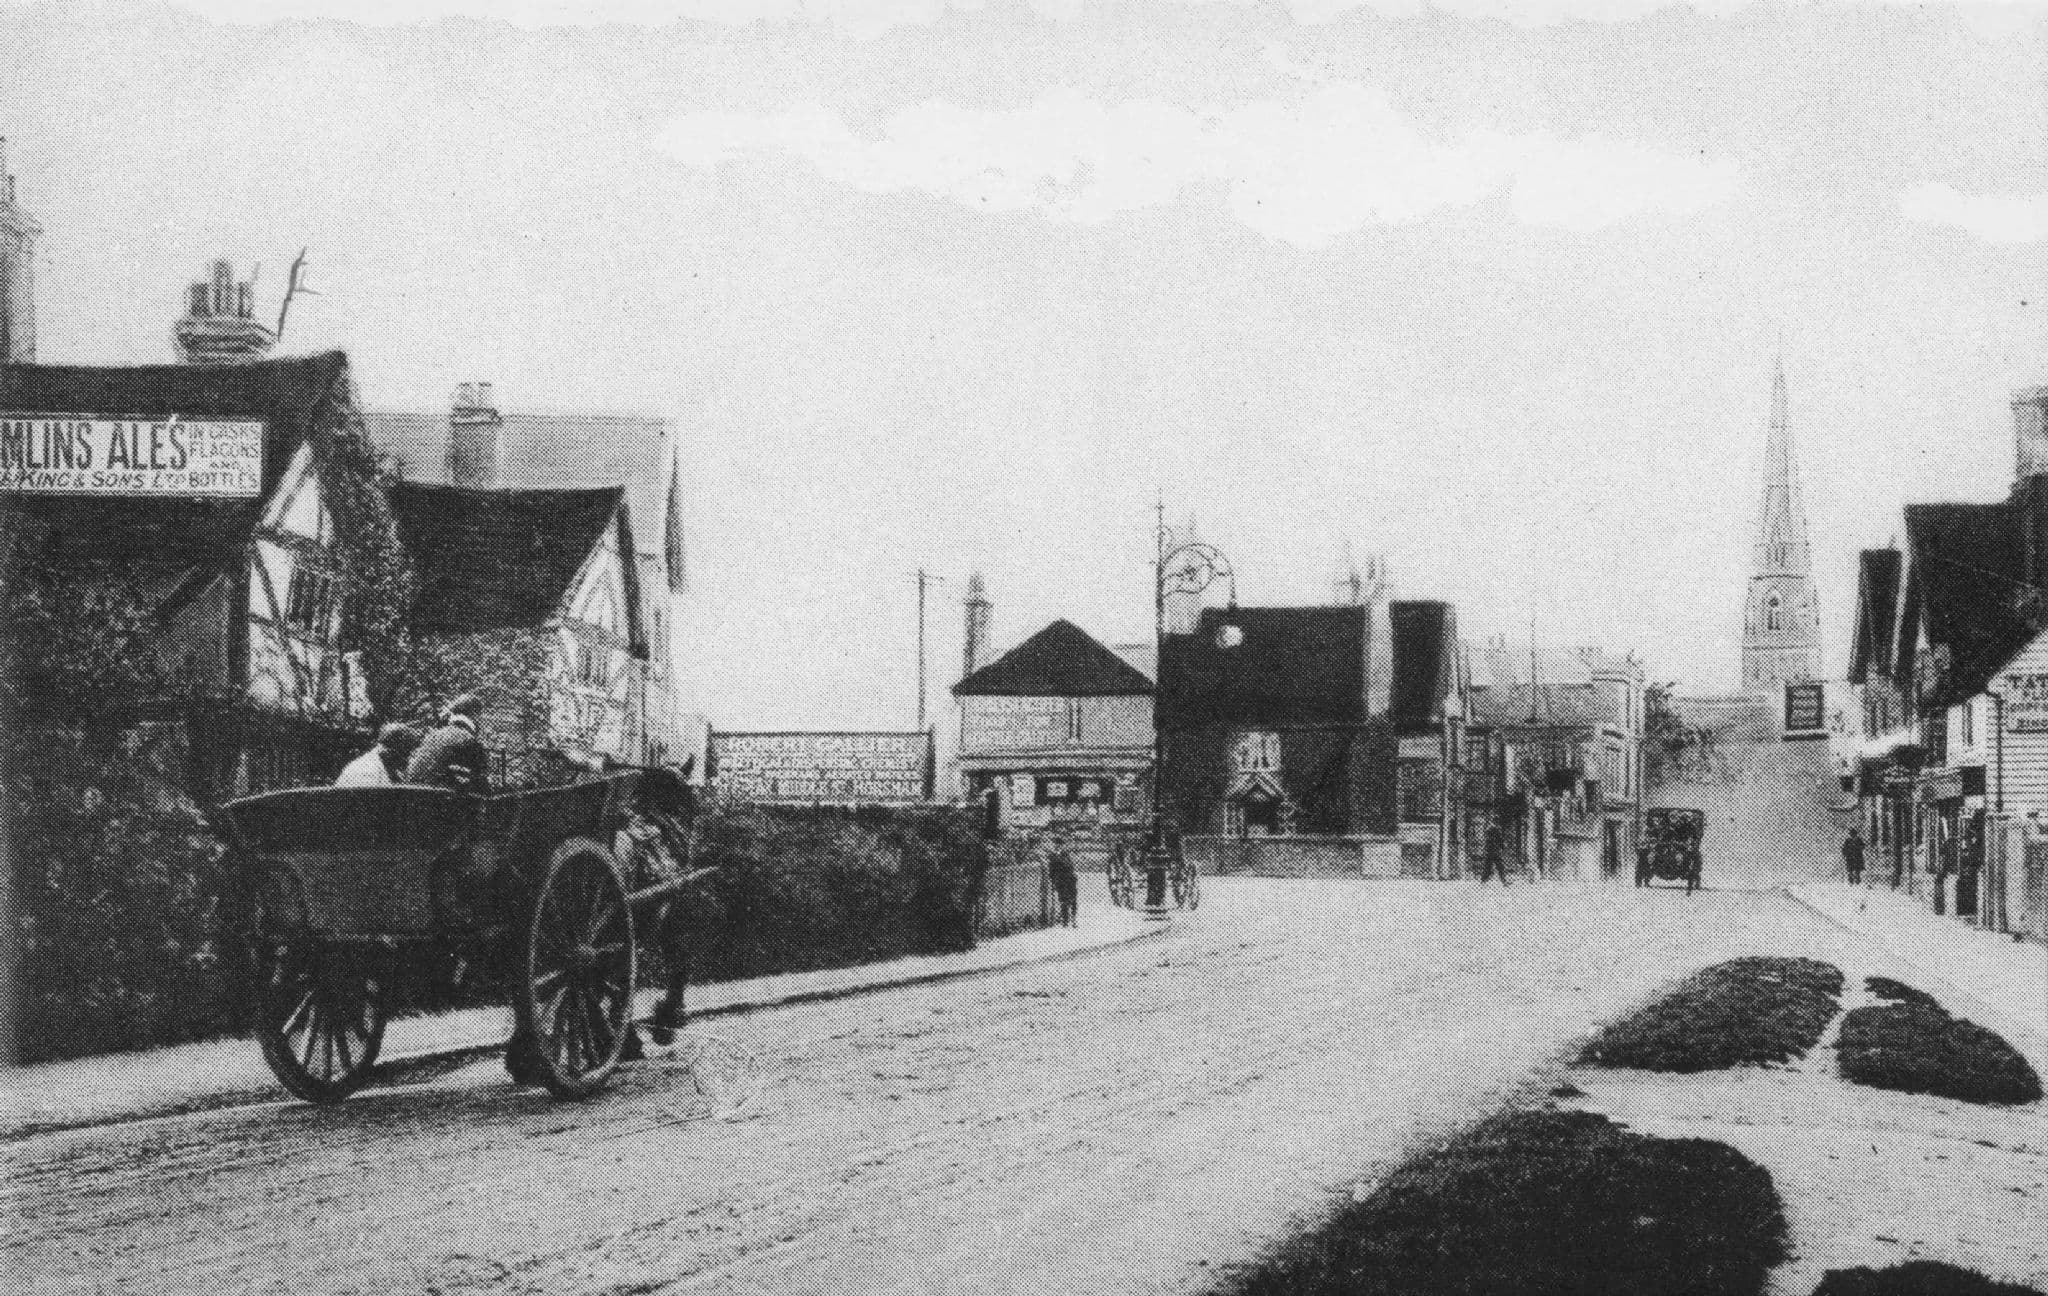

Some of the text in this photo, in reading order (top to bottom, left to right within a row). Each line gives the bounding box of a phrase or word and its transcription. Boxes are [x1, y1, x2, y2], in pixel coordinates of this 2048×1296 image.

[188, 424, 259, 439] IN CASKS
[107, 421, 188, 470] ALES
[189, 441, 259, 458] FLAGONS
[92, 471, 144, 488] SONS
[189, 471, 258, 488] BOTTLES
[853, 780, 924, 796] HORSHAM
